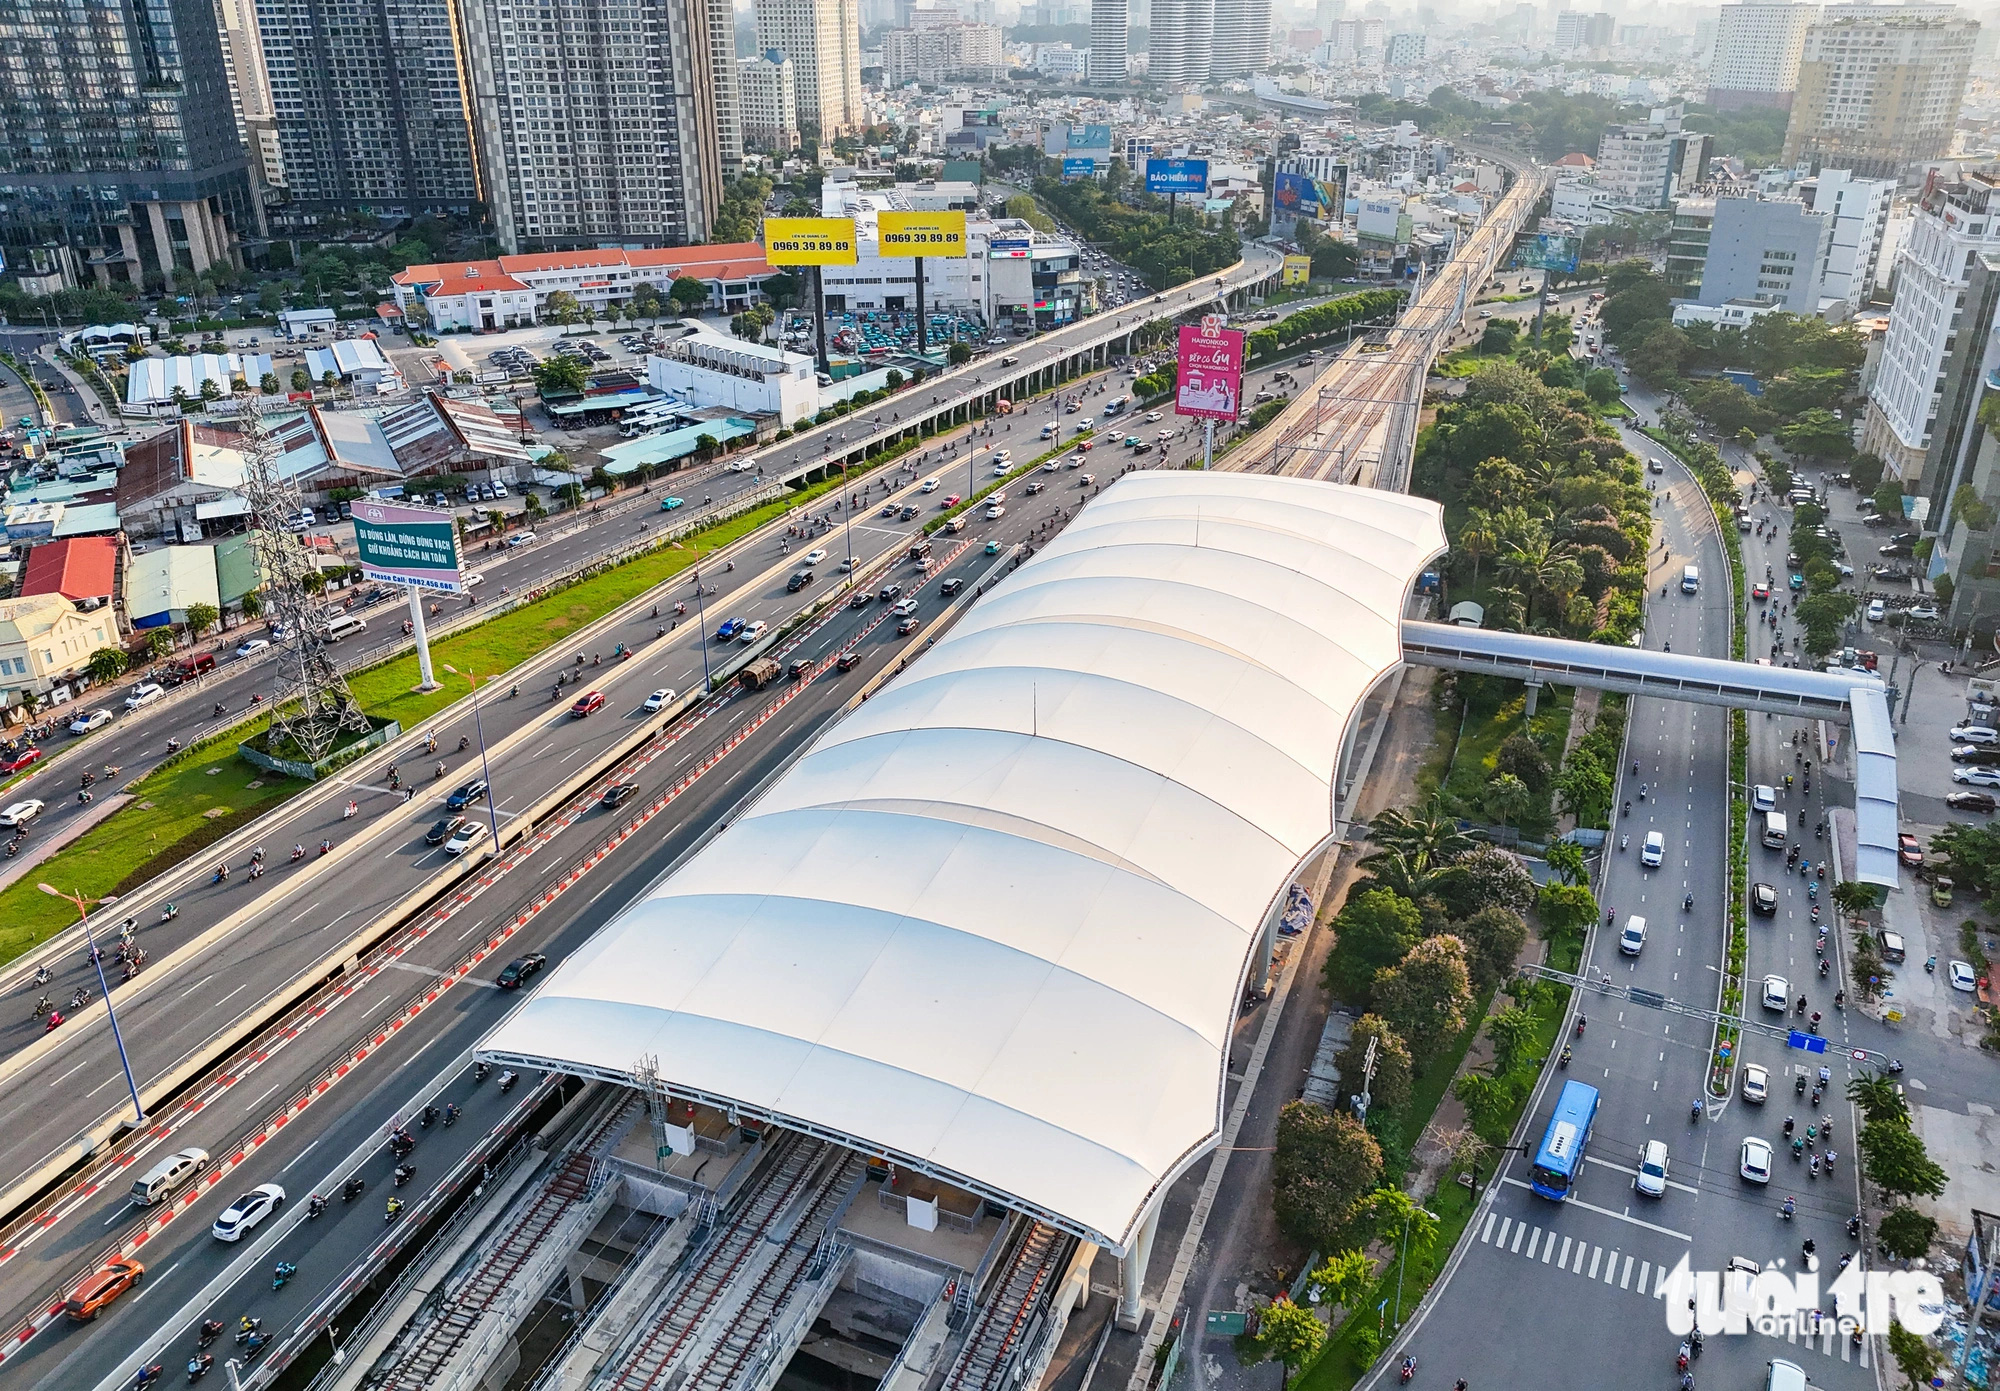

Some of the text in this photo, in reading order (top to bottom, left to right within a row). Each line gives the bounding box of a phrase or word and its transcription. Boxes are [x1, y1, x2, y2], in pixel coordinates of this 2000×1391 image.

[1150, 171, 1202, 182] BẢO HIỂM PVI
[885, 234, 959, 243] 0969.39.89.89
[773, 242, 849, 250] 0969.39.89.89
[1192, 337, 1228, 346] HAWONKOO
[434, 539, 450, 551] VẠCH
[367, 542, 447, 564] GIỮ KHOẢNG CÁCH AN TOÀN
[370, 573, 391, 581] Please
[392, 575, 407, 583] Call:
